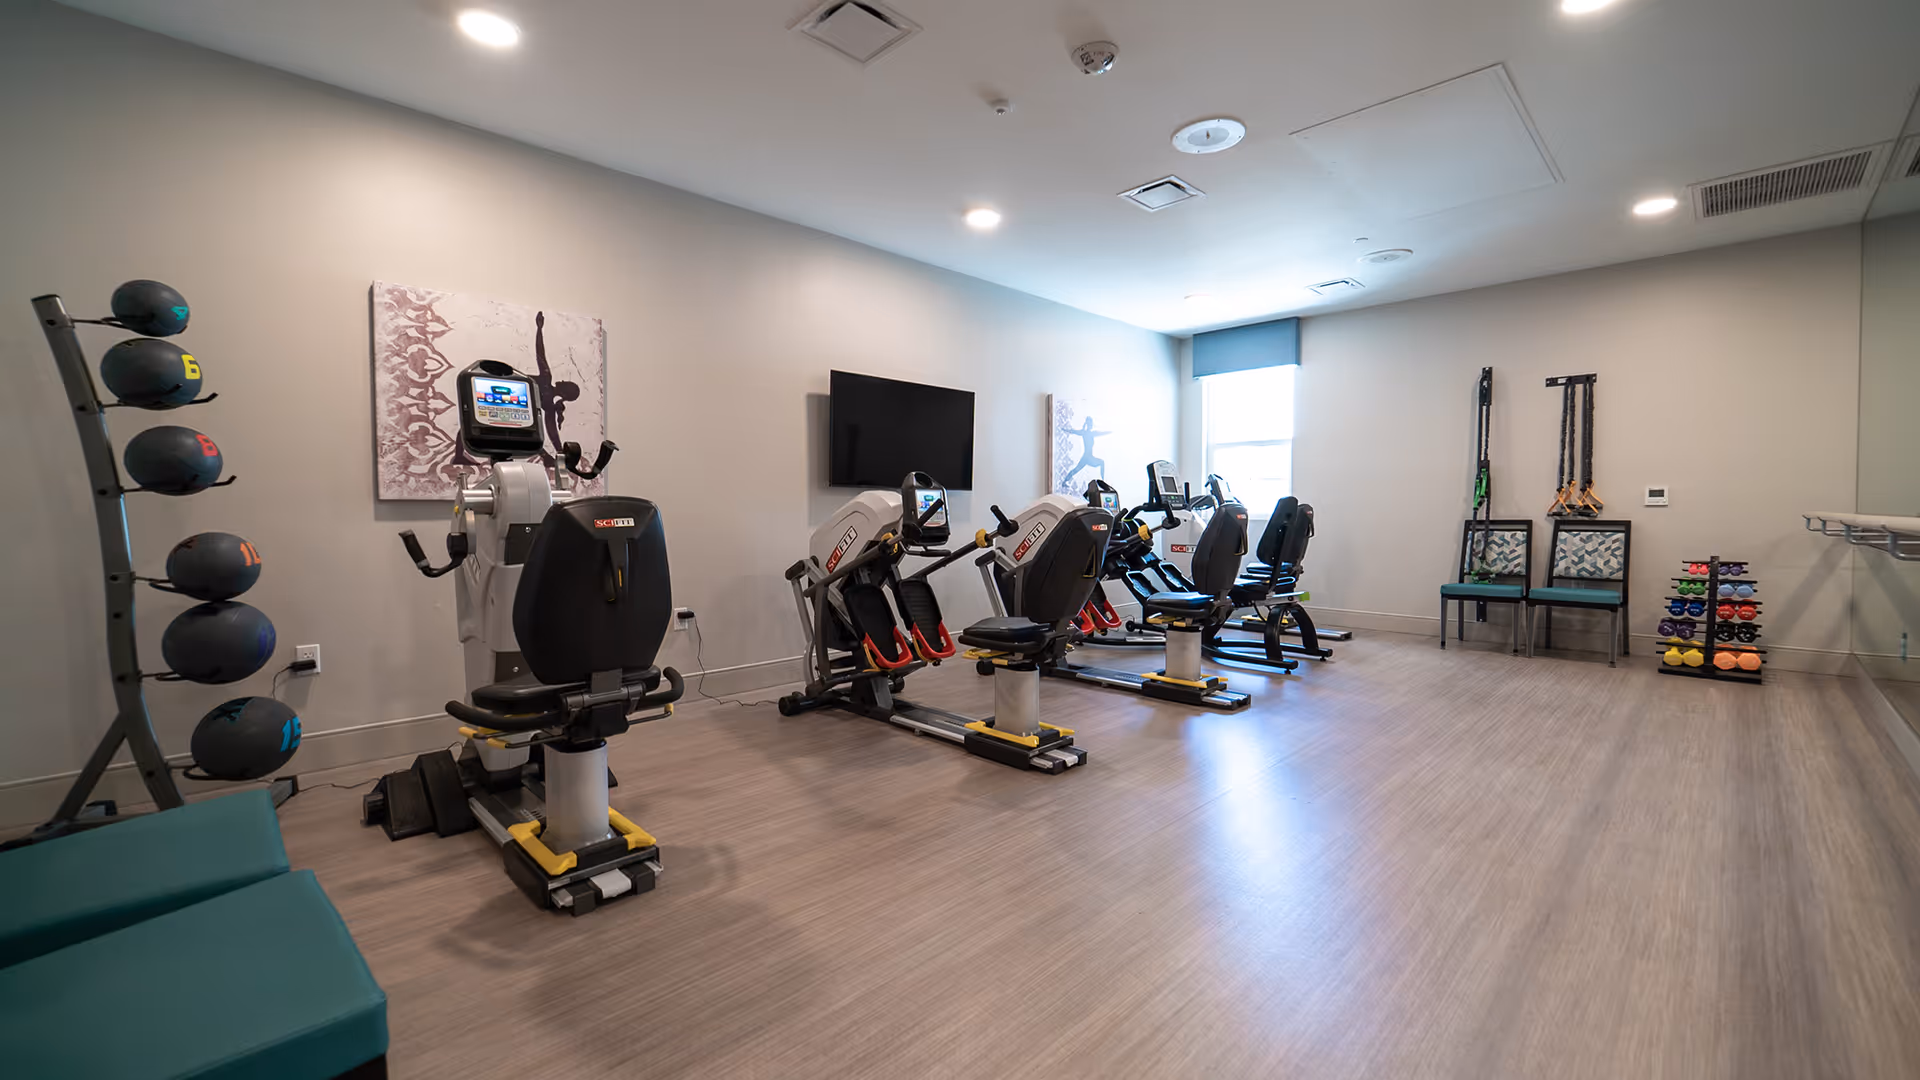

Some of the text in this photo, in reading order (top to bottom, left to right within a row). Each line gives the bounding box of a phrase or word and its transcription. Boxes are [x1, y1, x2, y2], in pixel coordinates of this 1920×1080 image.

[181, 354, 200, 379] 6
[195, 434, 218, 456] 8
[595, 518, 633, 527] SCIFIT
[827, 528, 855, 571] SCIFIT
[1014, 524, 1044, 560] SCIFIT
